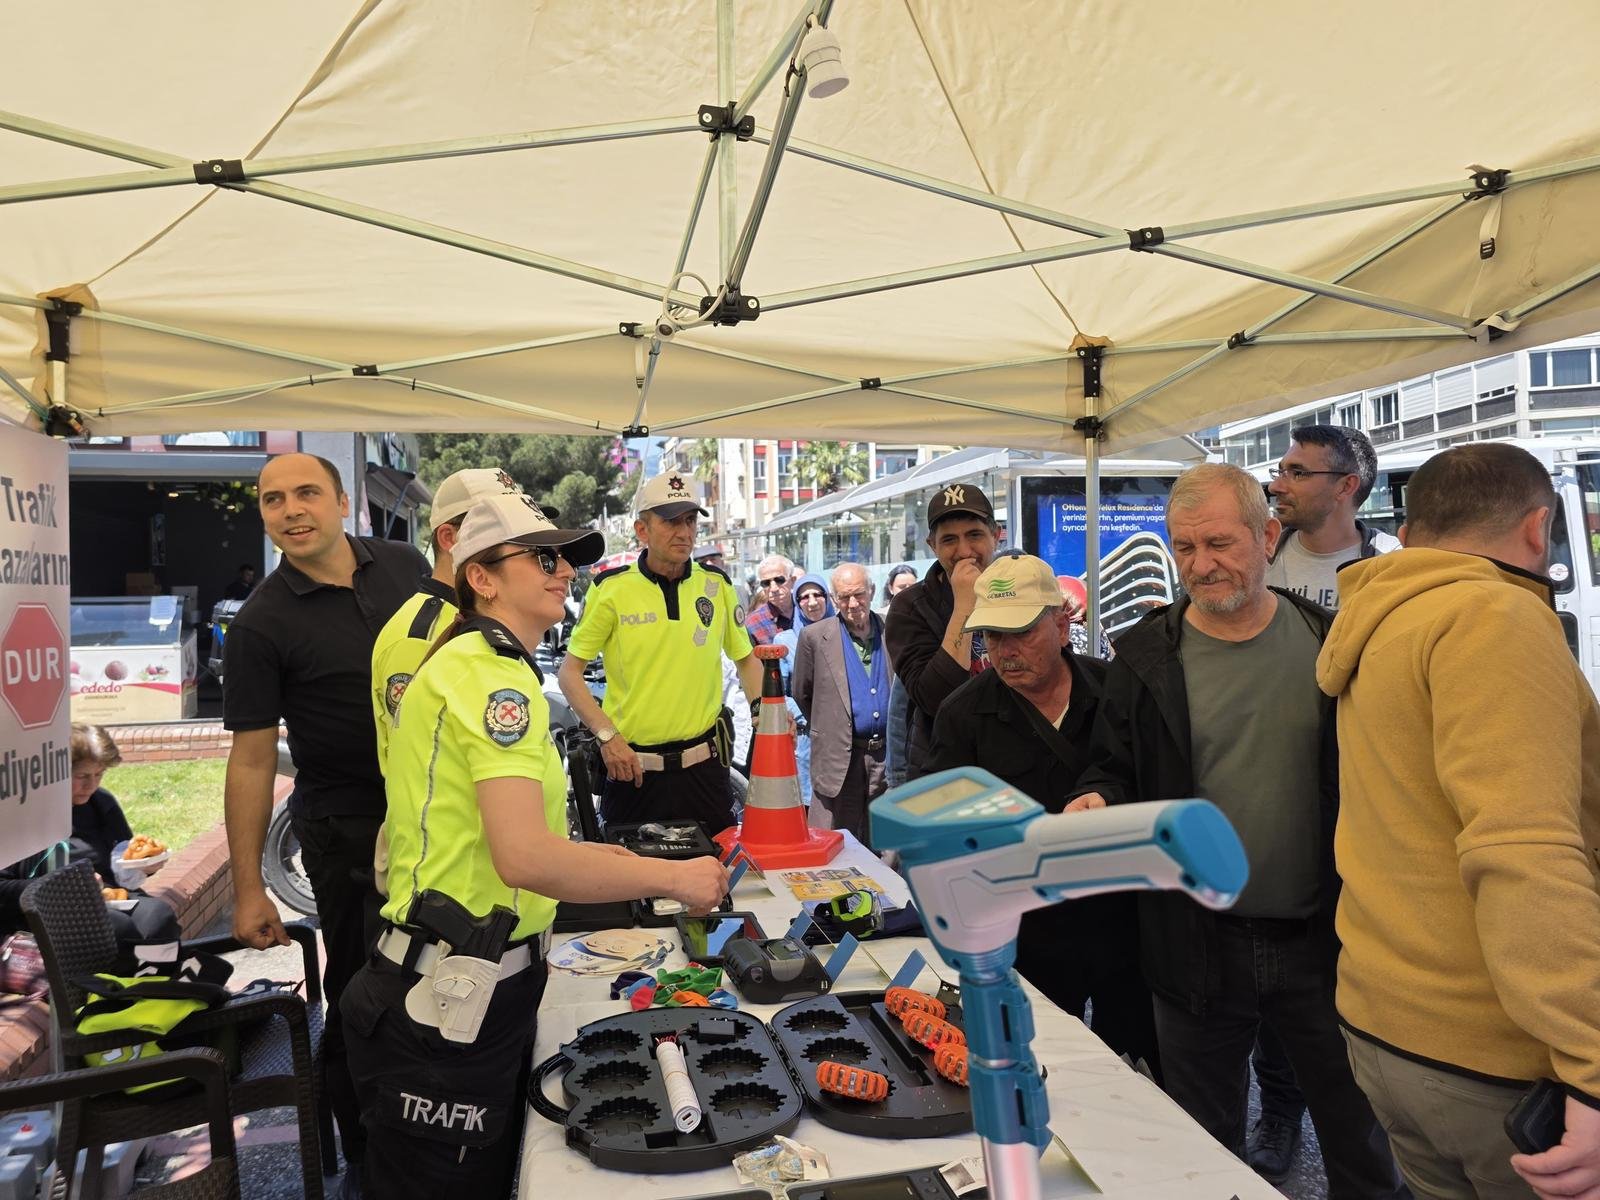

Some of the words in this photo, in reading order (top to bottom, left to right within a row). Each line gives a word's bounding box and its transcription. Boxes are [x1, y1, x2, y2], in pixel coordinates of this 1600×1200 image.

[1, 476, 57, 528] Trafik
[1114, 514, 1146, 523] premium
[0, 541, 70, 586] azaların
[5, 647, 61, 686] DUR
[0, 741, 69, 805] diyelim
